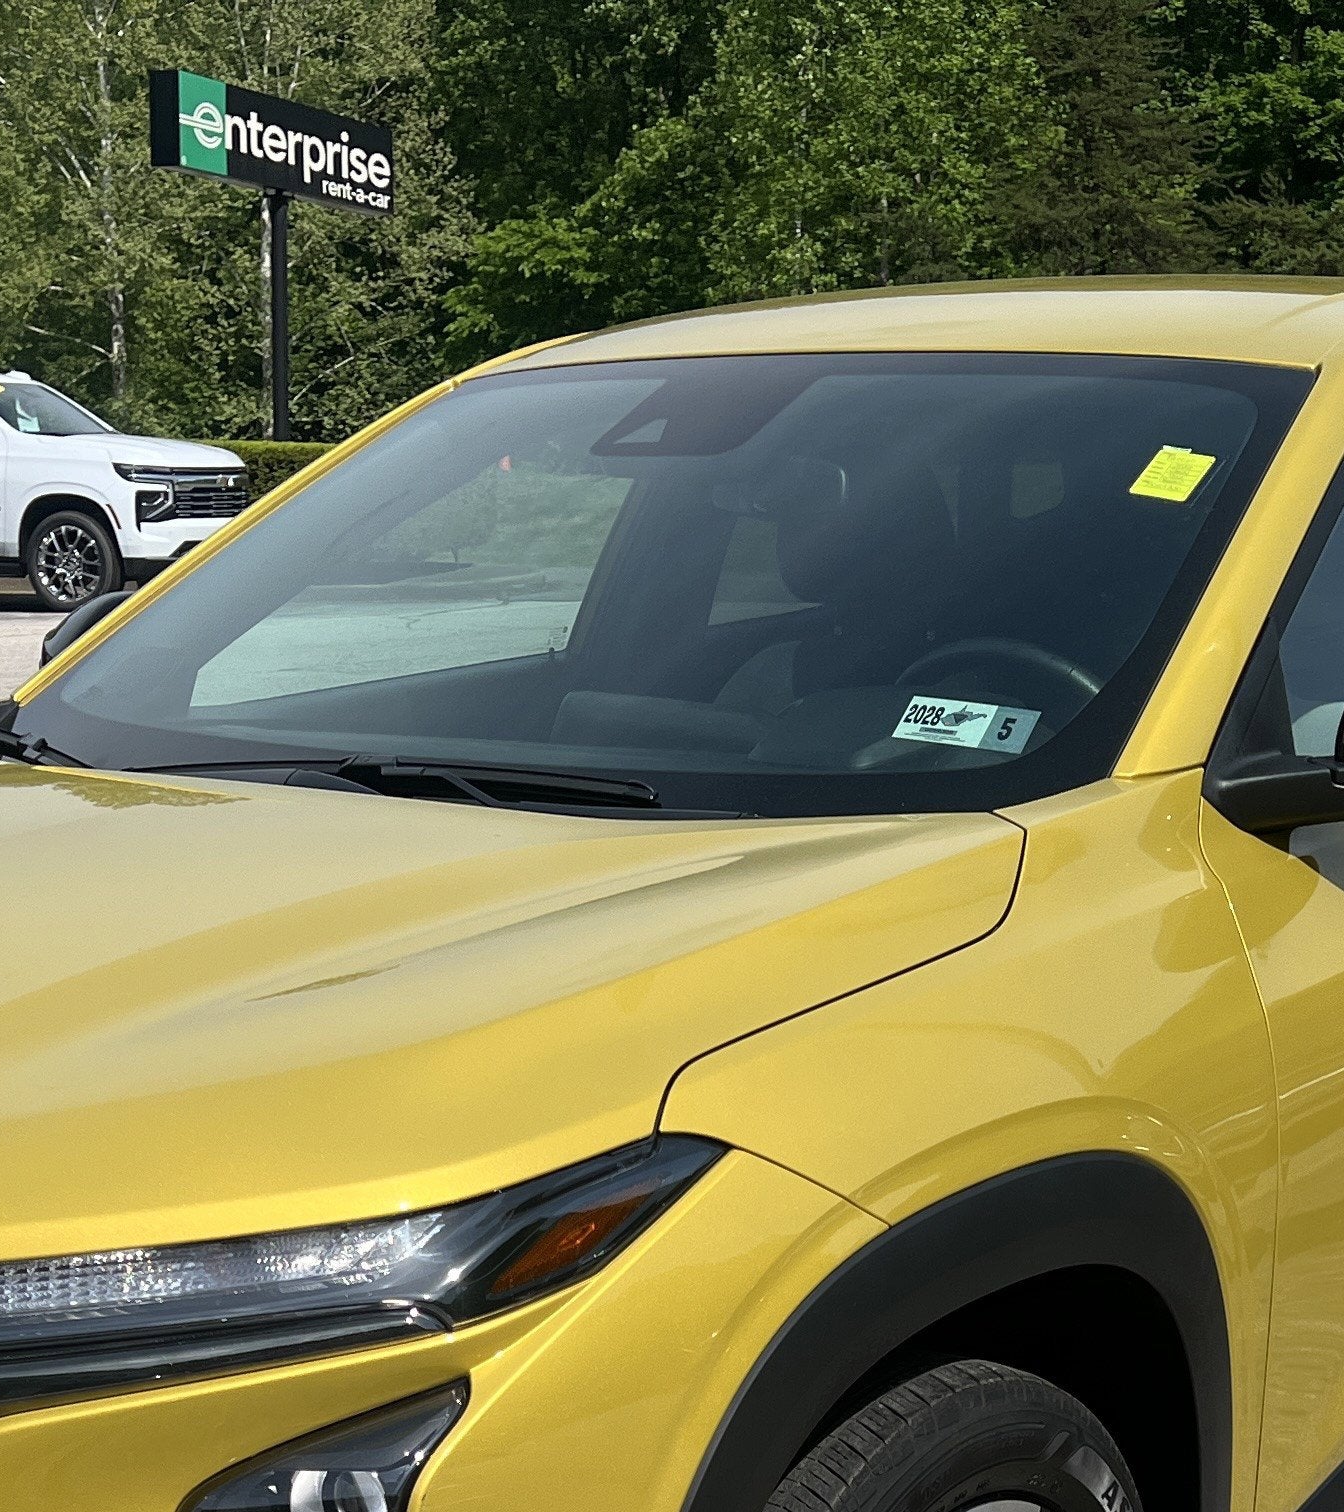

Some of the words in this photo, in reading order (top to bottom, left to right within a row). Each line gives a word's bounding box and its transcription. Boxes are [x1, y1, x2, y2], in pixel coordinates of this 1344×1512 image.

[179, 102, 392, 188] enterprise
[322, 179, 391, 209] rent-a-car
[903, 704, 946, 726] 2028
[997, 717, 1018, 741] 5
